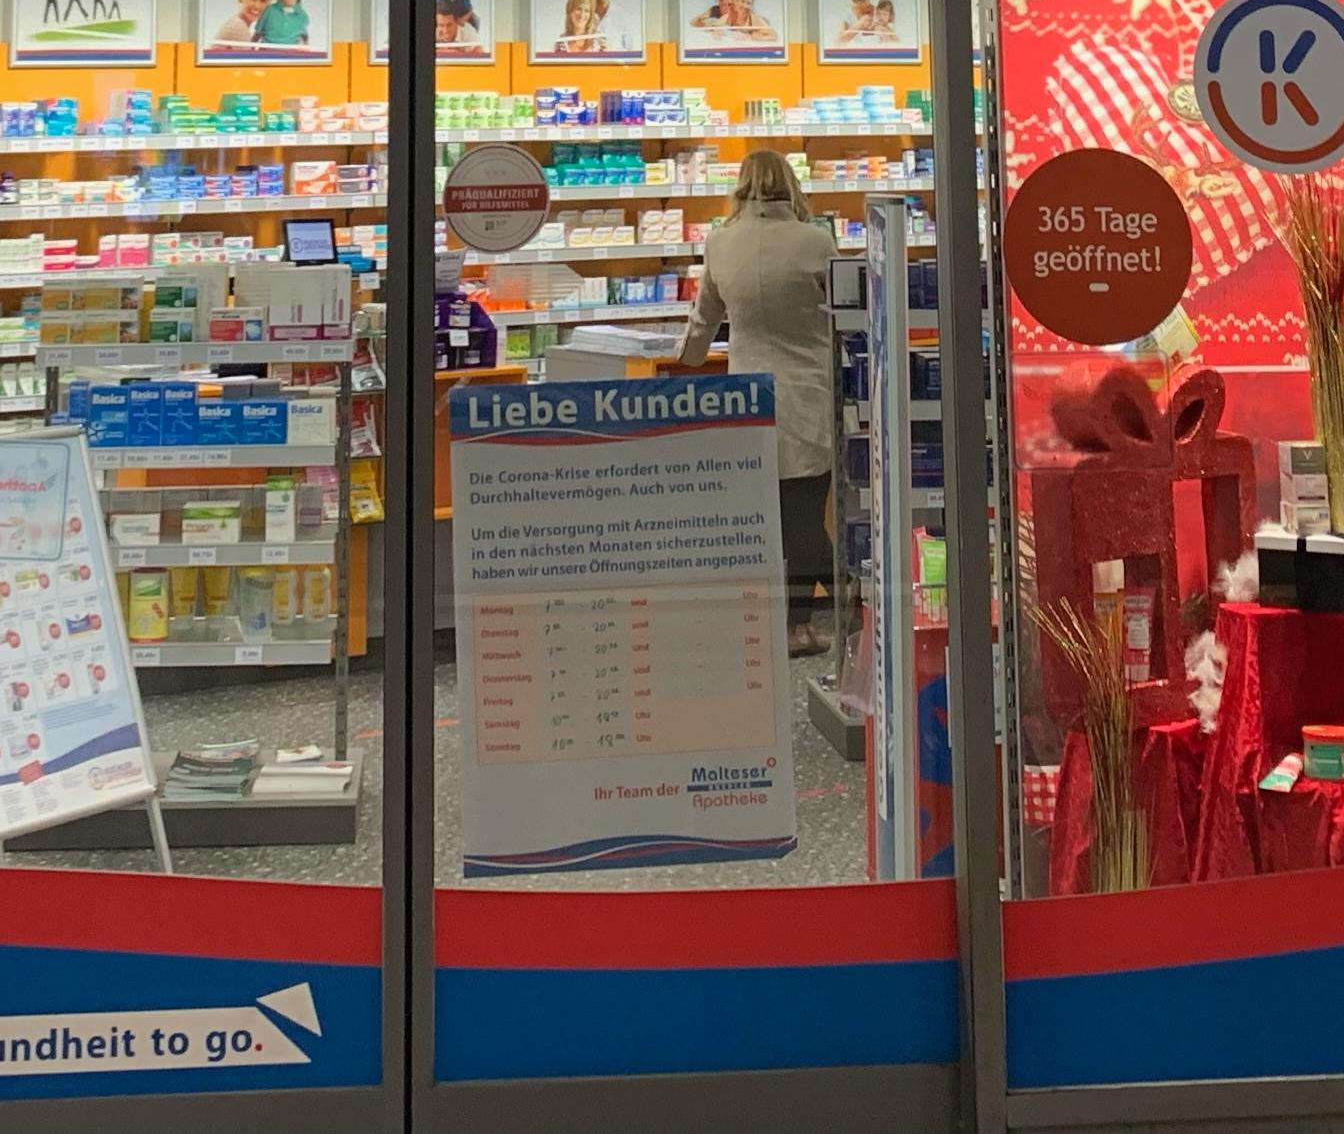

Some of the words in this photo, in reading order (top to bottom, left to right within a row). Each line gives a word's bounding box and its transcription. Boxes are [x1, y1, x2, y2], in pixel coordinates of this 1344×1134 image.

[1037, 206, 1086, 233] 365
[1093, 206, 1158, 239] Tage
[1033, 245, 1162, 278] geöffnet!
[92, 393, 127, 404] Basica
[130, 389, 160, 400] Basica
[164, 389, 194, 400] Basica
[467, 391, 579, 429] Liebe
[593, 382, 760, 423] Kunden!
[198, 406, 232, 417] Basica
[242, 405, 277, 417] Basica
[290, 404, 323, 415] Basica
[470, 470, 493, 485] Die
[498, 466, 590, 484] Corona-Krise
[595, 462, 659, 478] erfordert
[665, 463, 691, 474] von
[696, 457, 732, 473] Allen
[737, 456, 763, 470] viel
[470, 487, 626, 505] Durchhaltevermögen.
[629, 482, 665, 496] Auch
[669, 483, 695, 494] von
[698, 480, 728, 493] uns.
[470, 527, 495, 541] Um
[499, 525, 520, 539] die
[523, 522, 604, 541] Versorgung
[608, 519, 631, 533] mit
[634, 514, 729, 532] Arzneimitteln
[732, 511, 765, 526] auch
[471, 547, 485, 561] in
[488, 546, 516, 560] den
[520, 542, 585, 558] nächsten
[588, 538, 653, 554] Monaten
[656, 533, 767, 550] sicherzustellen,
[472, 567, 515, 581] haben
[518, 565, 539, 578] wir
[541, 564, 586, 577] unsere
[589, 557, 693, 577] Öffnungszeiten
[694, 551, 767, 570] angepasst.
[691, 765, 768, 783] Malteser
[593, 786, 613, 801] Ihr
[616, 785, 653, 800] Team
[656, 783, 681, 798] der
[692, 792, 769, 811] Apotheke
[150, 1027, 190, 1057] to
[205, 1028, 263, 1065] go.
